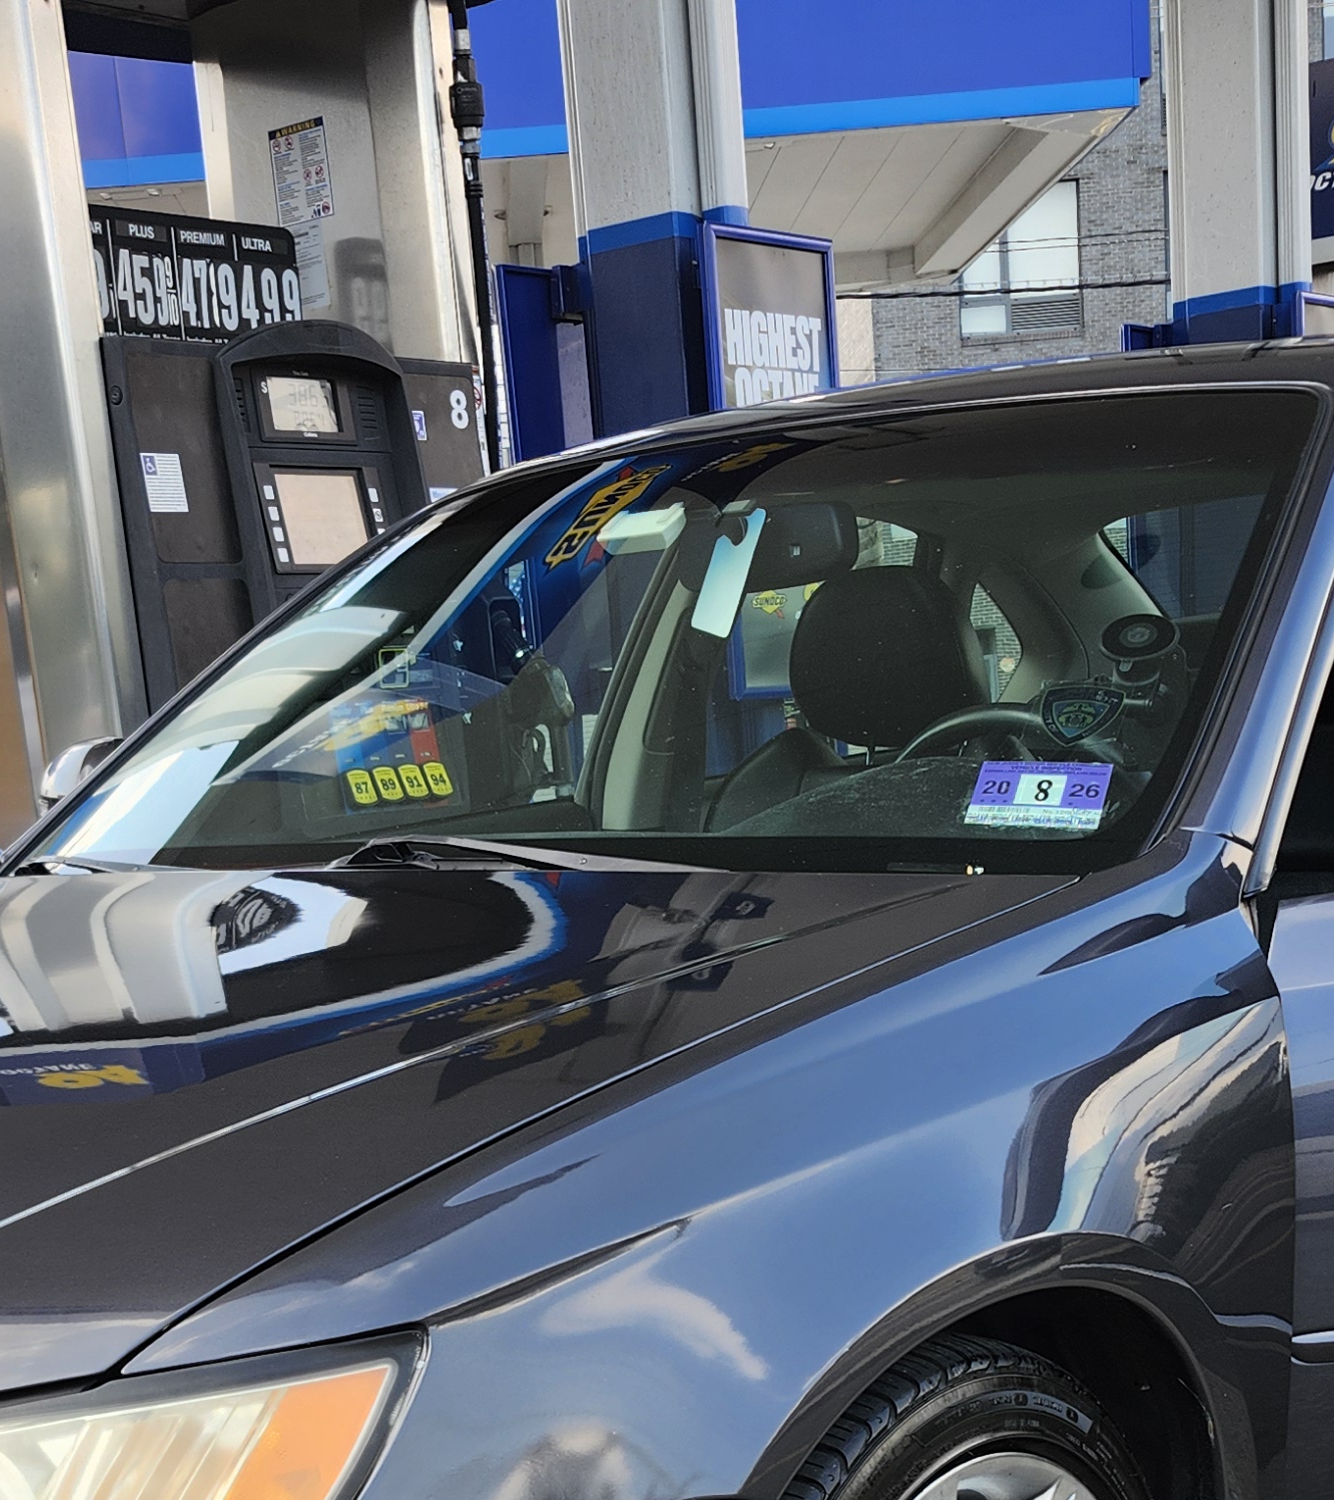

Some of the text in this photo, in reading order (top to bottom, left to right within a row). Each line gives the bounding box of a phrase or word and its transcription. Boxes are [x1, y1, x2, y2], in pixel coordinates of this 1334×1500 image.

[128, 223, 155, 239] PLUS
[180, 230, 225, 247] PREMIUM
[241, 236, 273, 252] ULTRA
[724, 308, 822, 373] HIGHEST
[449, 389, 469, 430] 8
[753, 596, 787, 607] SUNOCO
[354, 781, 370, 795] 87
[380, 778, 397, 791] 89
[405, 775, 422, 789] 91
[430, 773, 447, 787] 94
[981, 779, 1101, 802] 20 8 26
